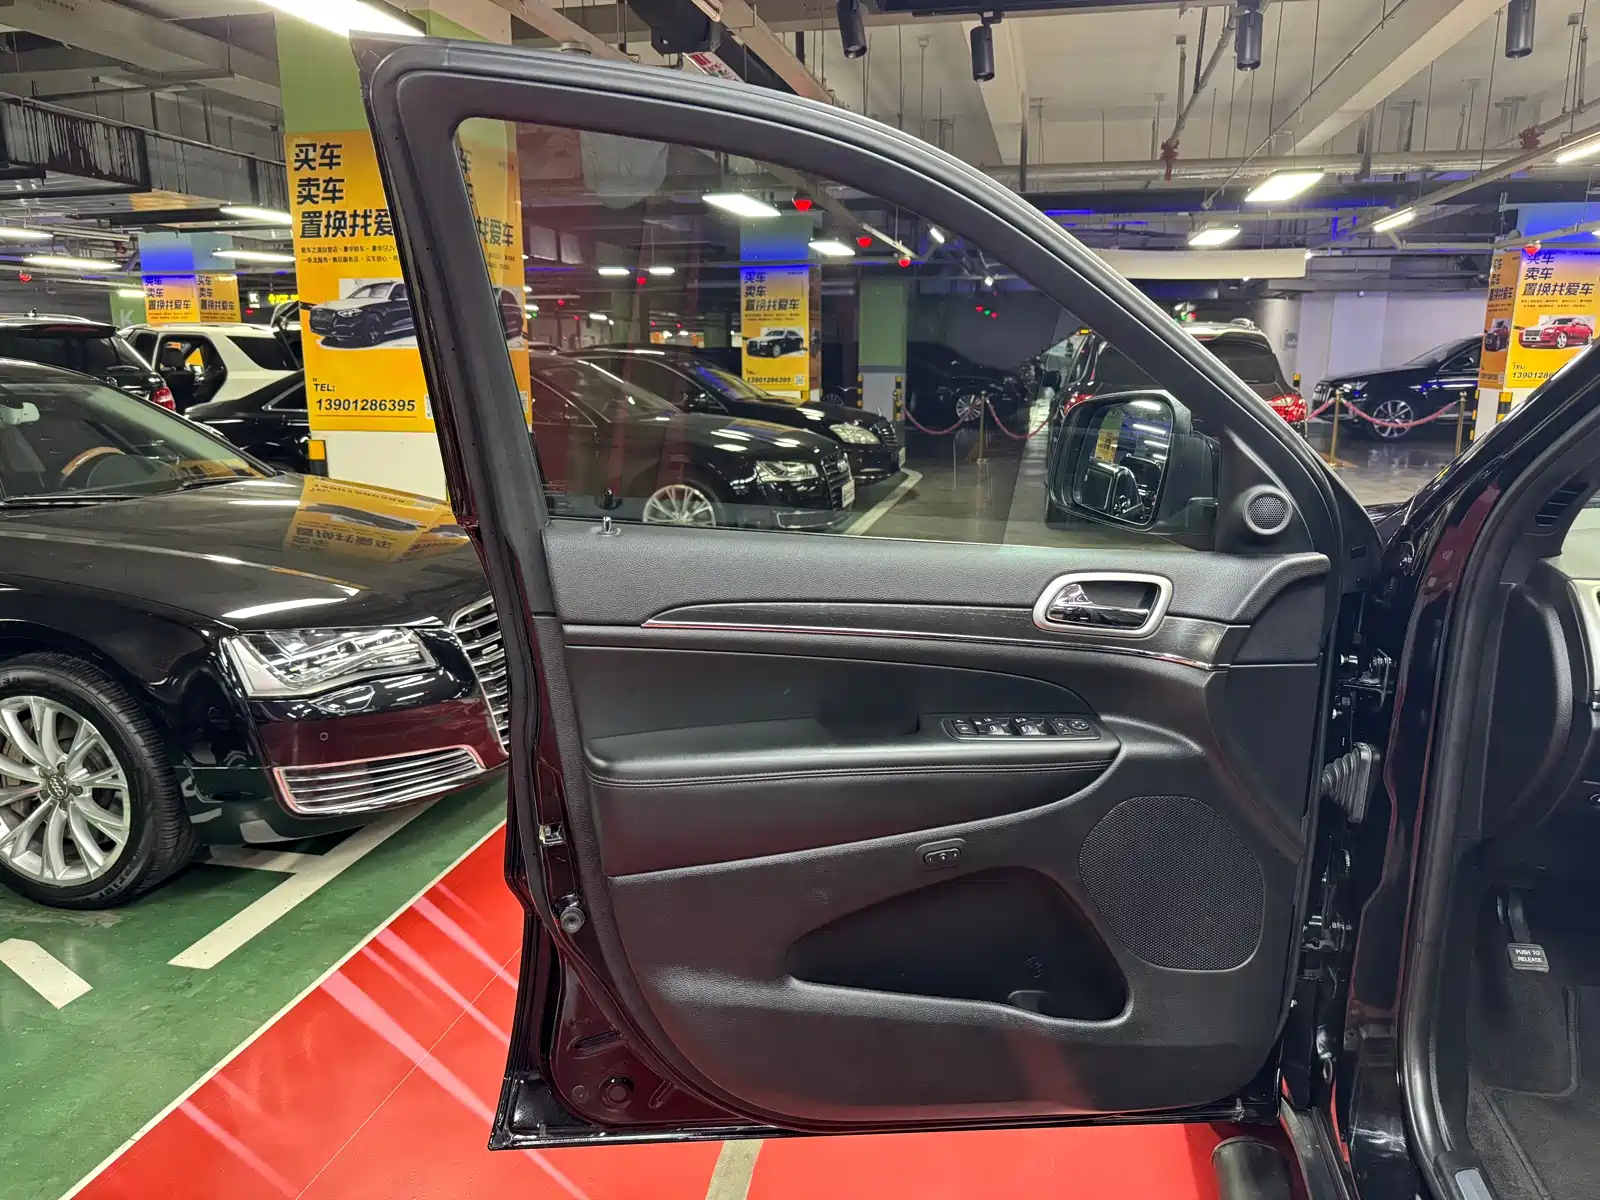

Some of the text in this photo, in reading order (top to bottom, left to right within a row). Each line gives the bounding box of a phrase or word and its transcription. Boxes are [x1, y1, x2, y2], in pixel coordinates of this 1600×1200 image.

[294, 143, 342, 171] 买车
[297, 177, 344, 205] 卖车
[300, 209, 393, 238] 置换找爱
[478, 216, 514, 247] 找爱车
[745, 272, 766, 283] 买车
[1524, 267, 1554, 280] 卖车
[1522, 283, 1595, 296] 置换找爱车
[148, 300, 191, 310] 置换找爱车
[314, 383, 335, 392] TEL:
[316, 398, 416, 412] 13901286395
